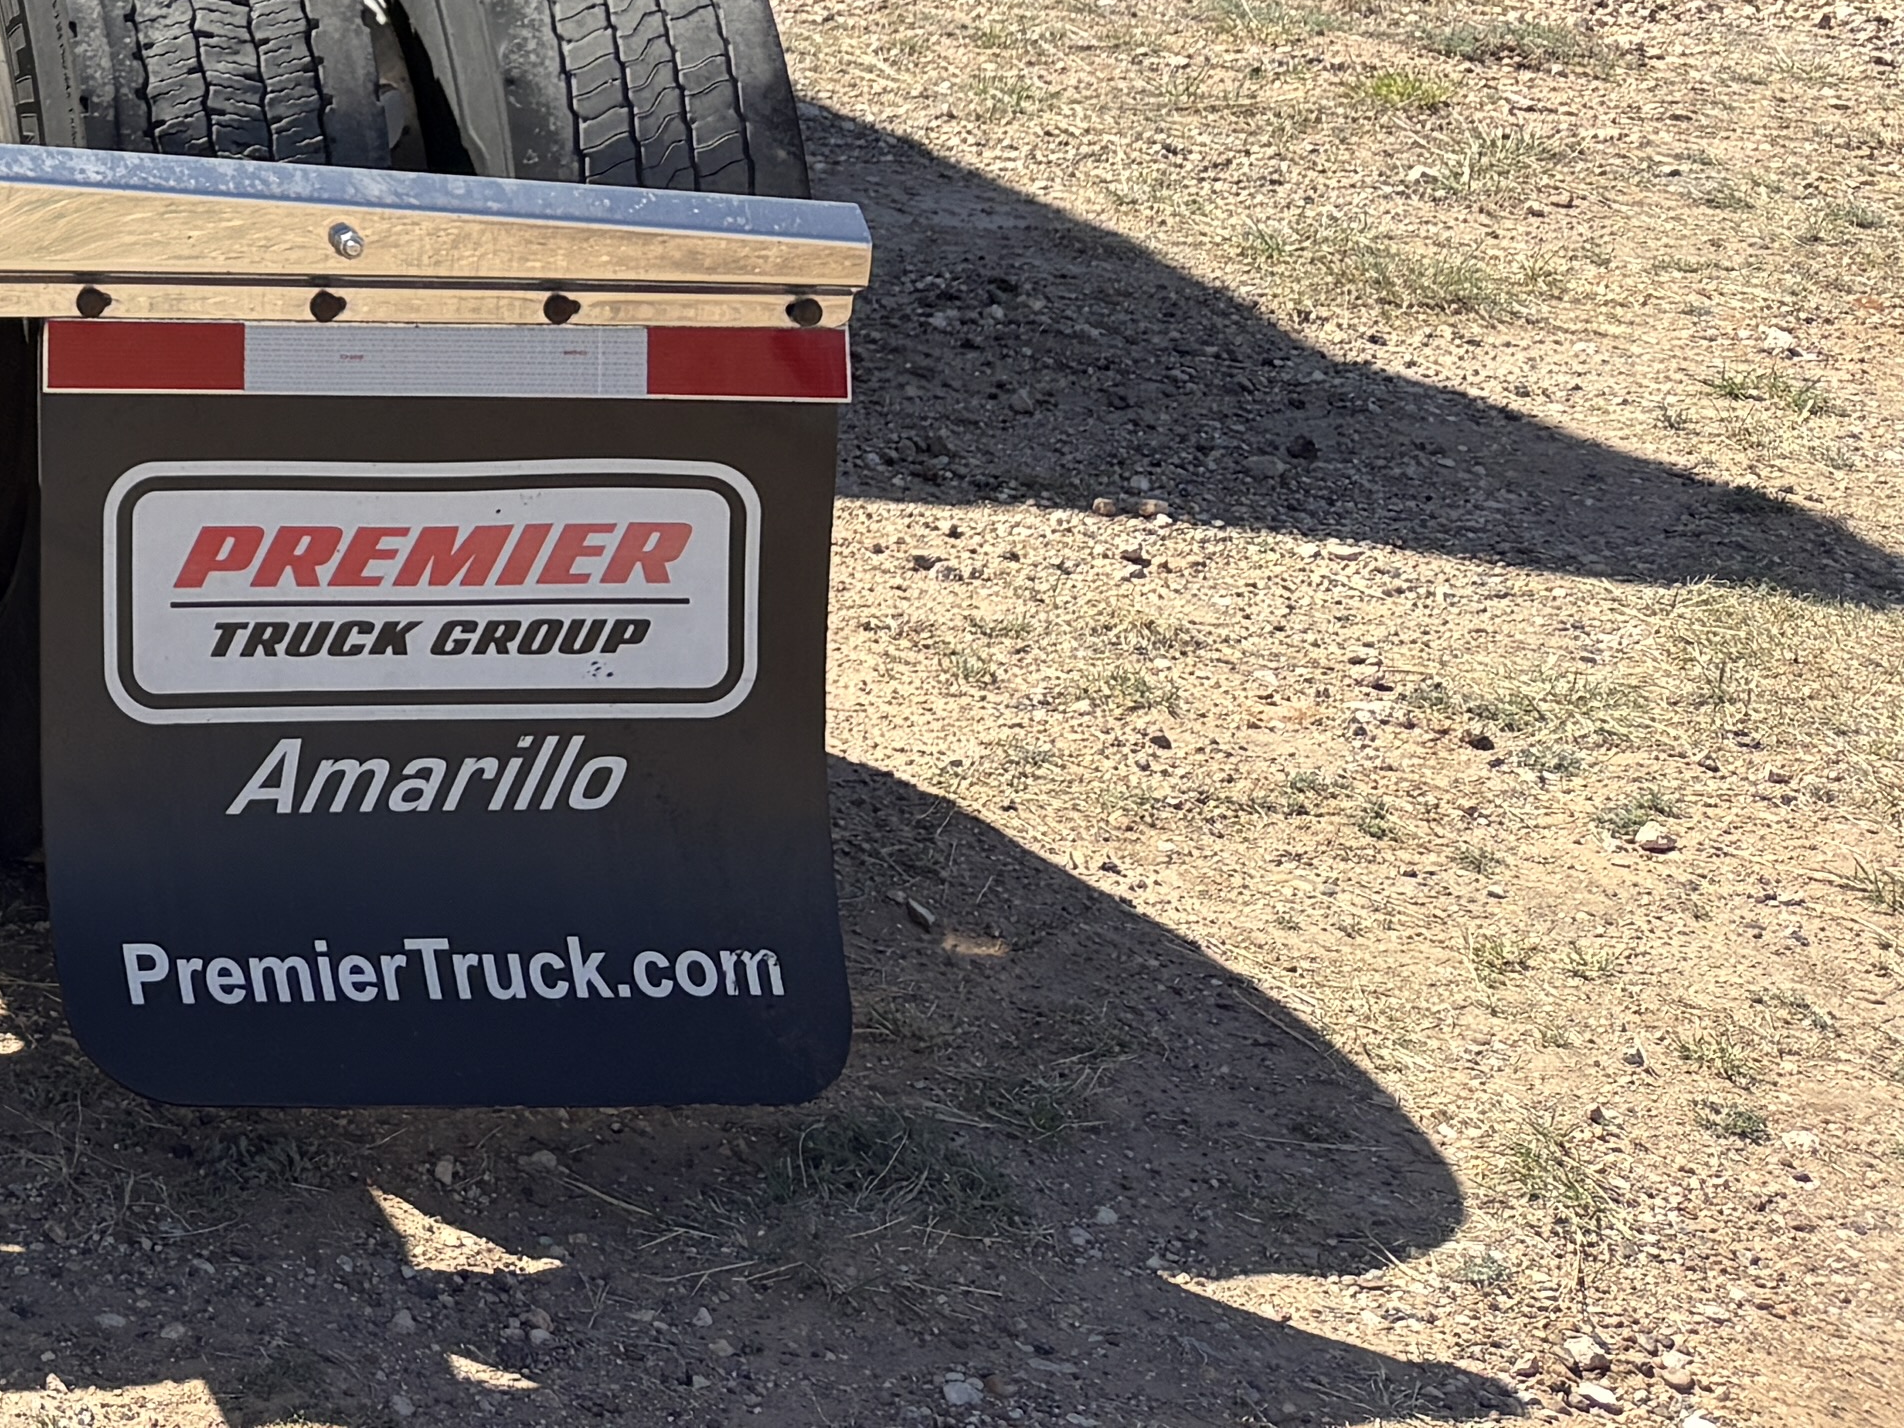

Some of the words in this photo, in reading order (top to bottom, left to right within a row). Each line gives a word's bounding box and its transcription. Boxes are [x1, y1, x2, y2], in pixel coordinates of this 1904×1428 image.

[172, 521, 693, 589] PREMIER
[210, 620, 423, 658] TRUCK
[430, 618, 651, 656] GROUP
[225, 735, 628, 815] Amarillo
[122, 936, 785, 1005] PremierTruck.com
